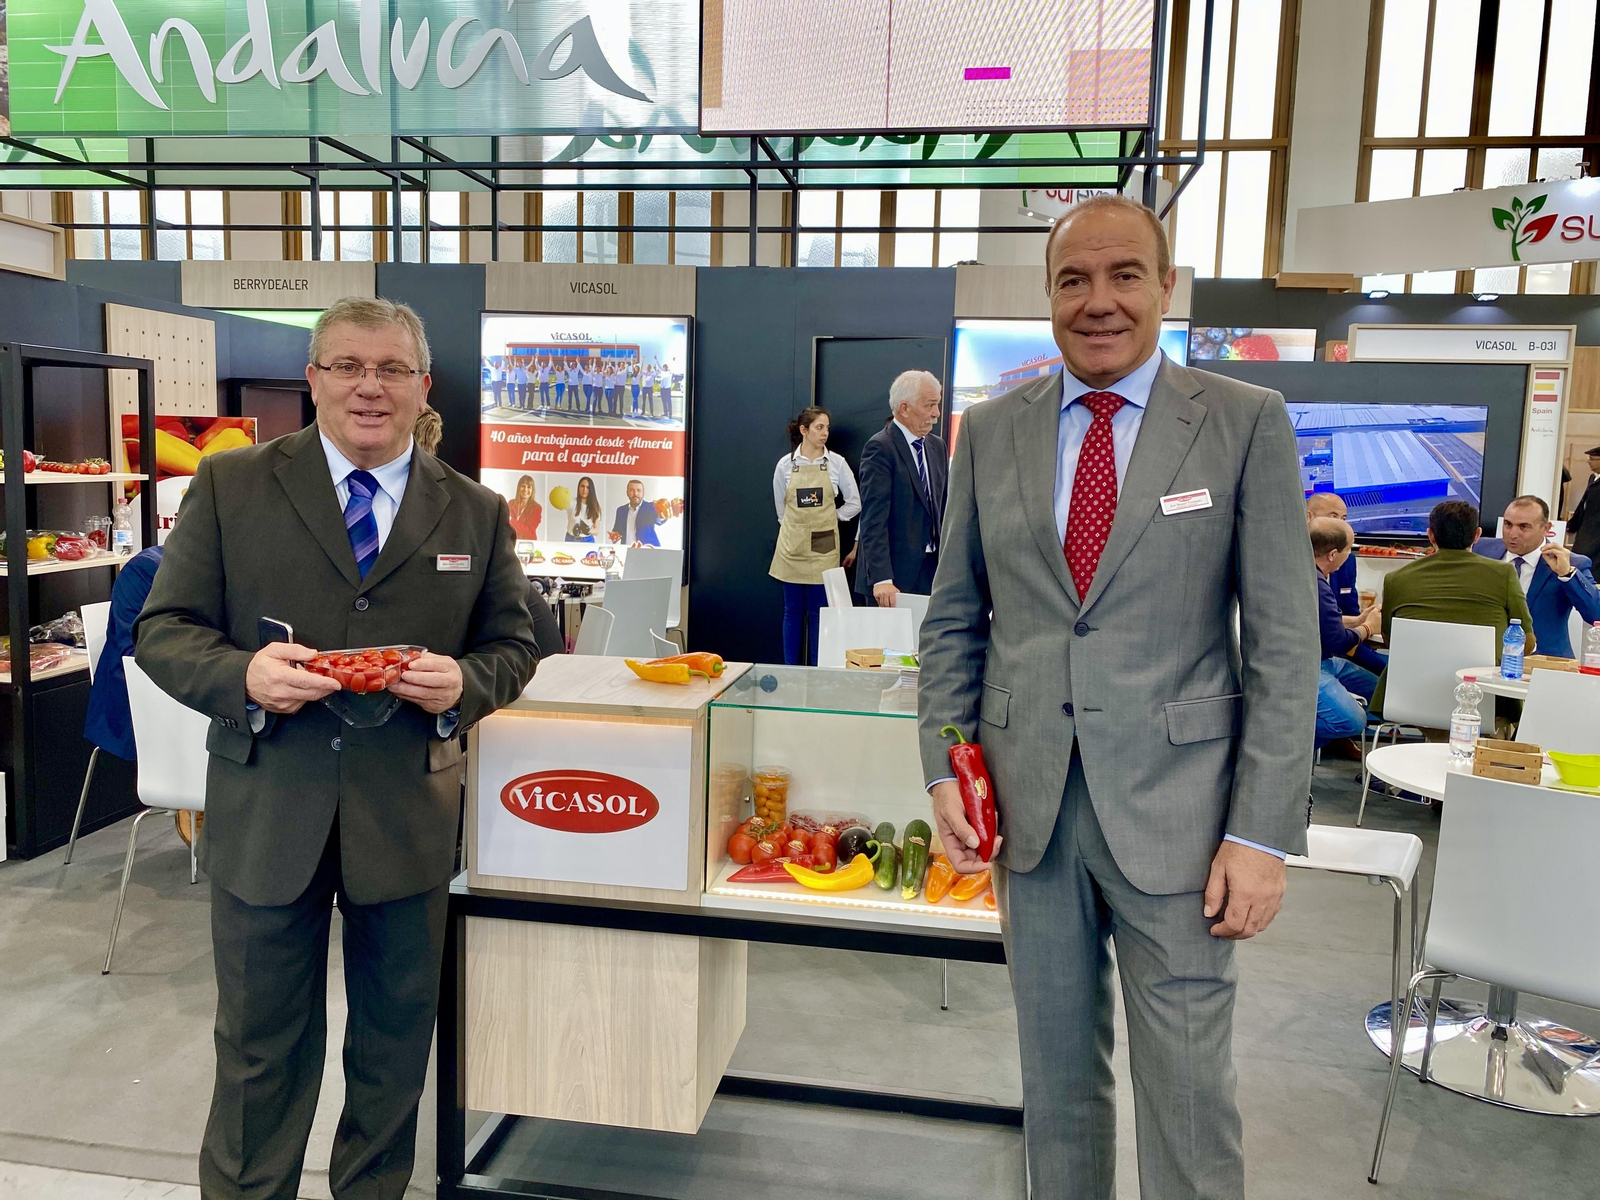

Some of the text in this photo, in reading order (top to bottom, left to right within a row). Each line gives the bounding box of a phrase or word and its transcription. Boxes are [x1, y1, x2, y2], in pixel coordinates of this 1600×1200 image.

[233, 278, 309, 291] BERRYDEALER
[569, 281, 618, 295] VICASOL
[1475, 340, 1517, 351] VICASOL
[1531, 407, 1553, 415] Spain
[490, 430, 673, 450] 40 años trabajando desde Almería
[521, 449, 640, 468] para el agricultor
